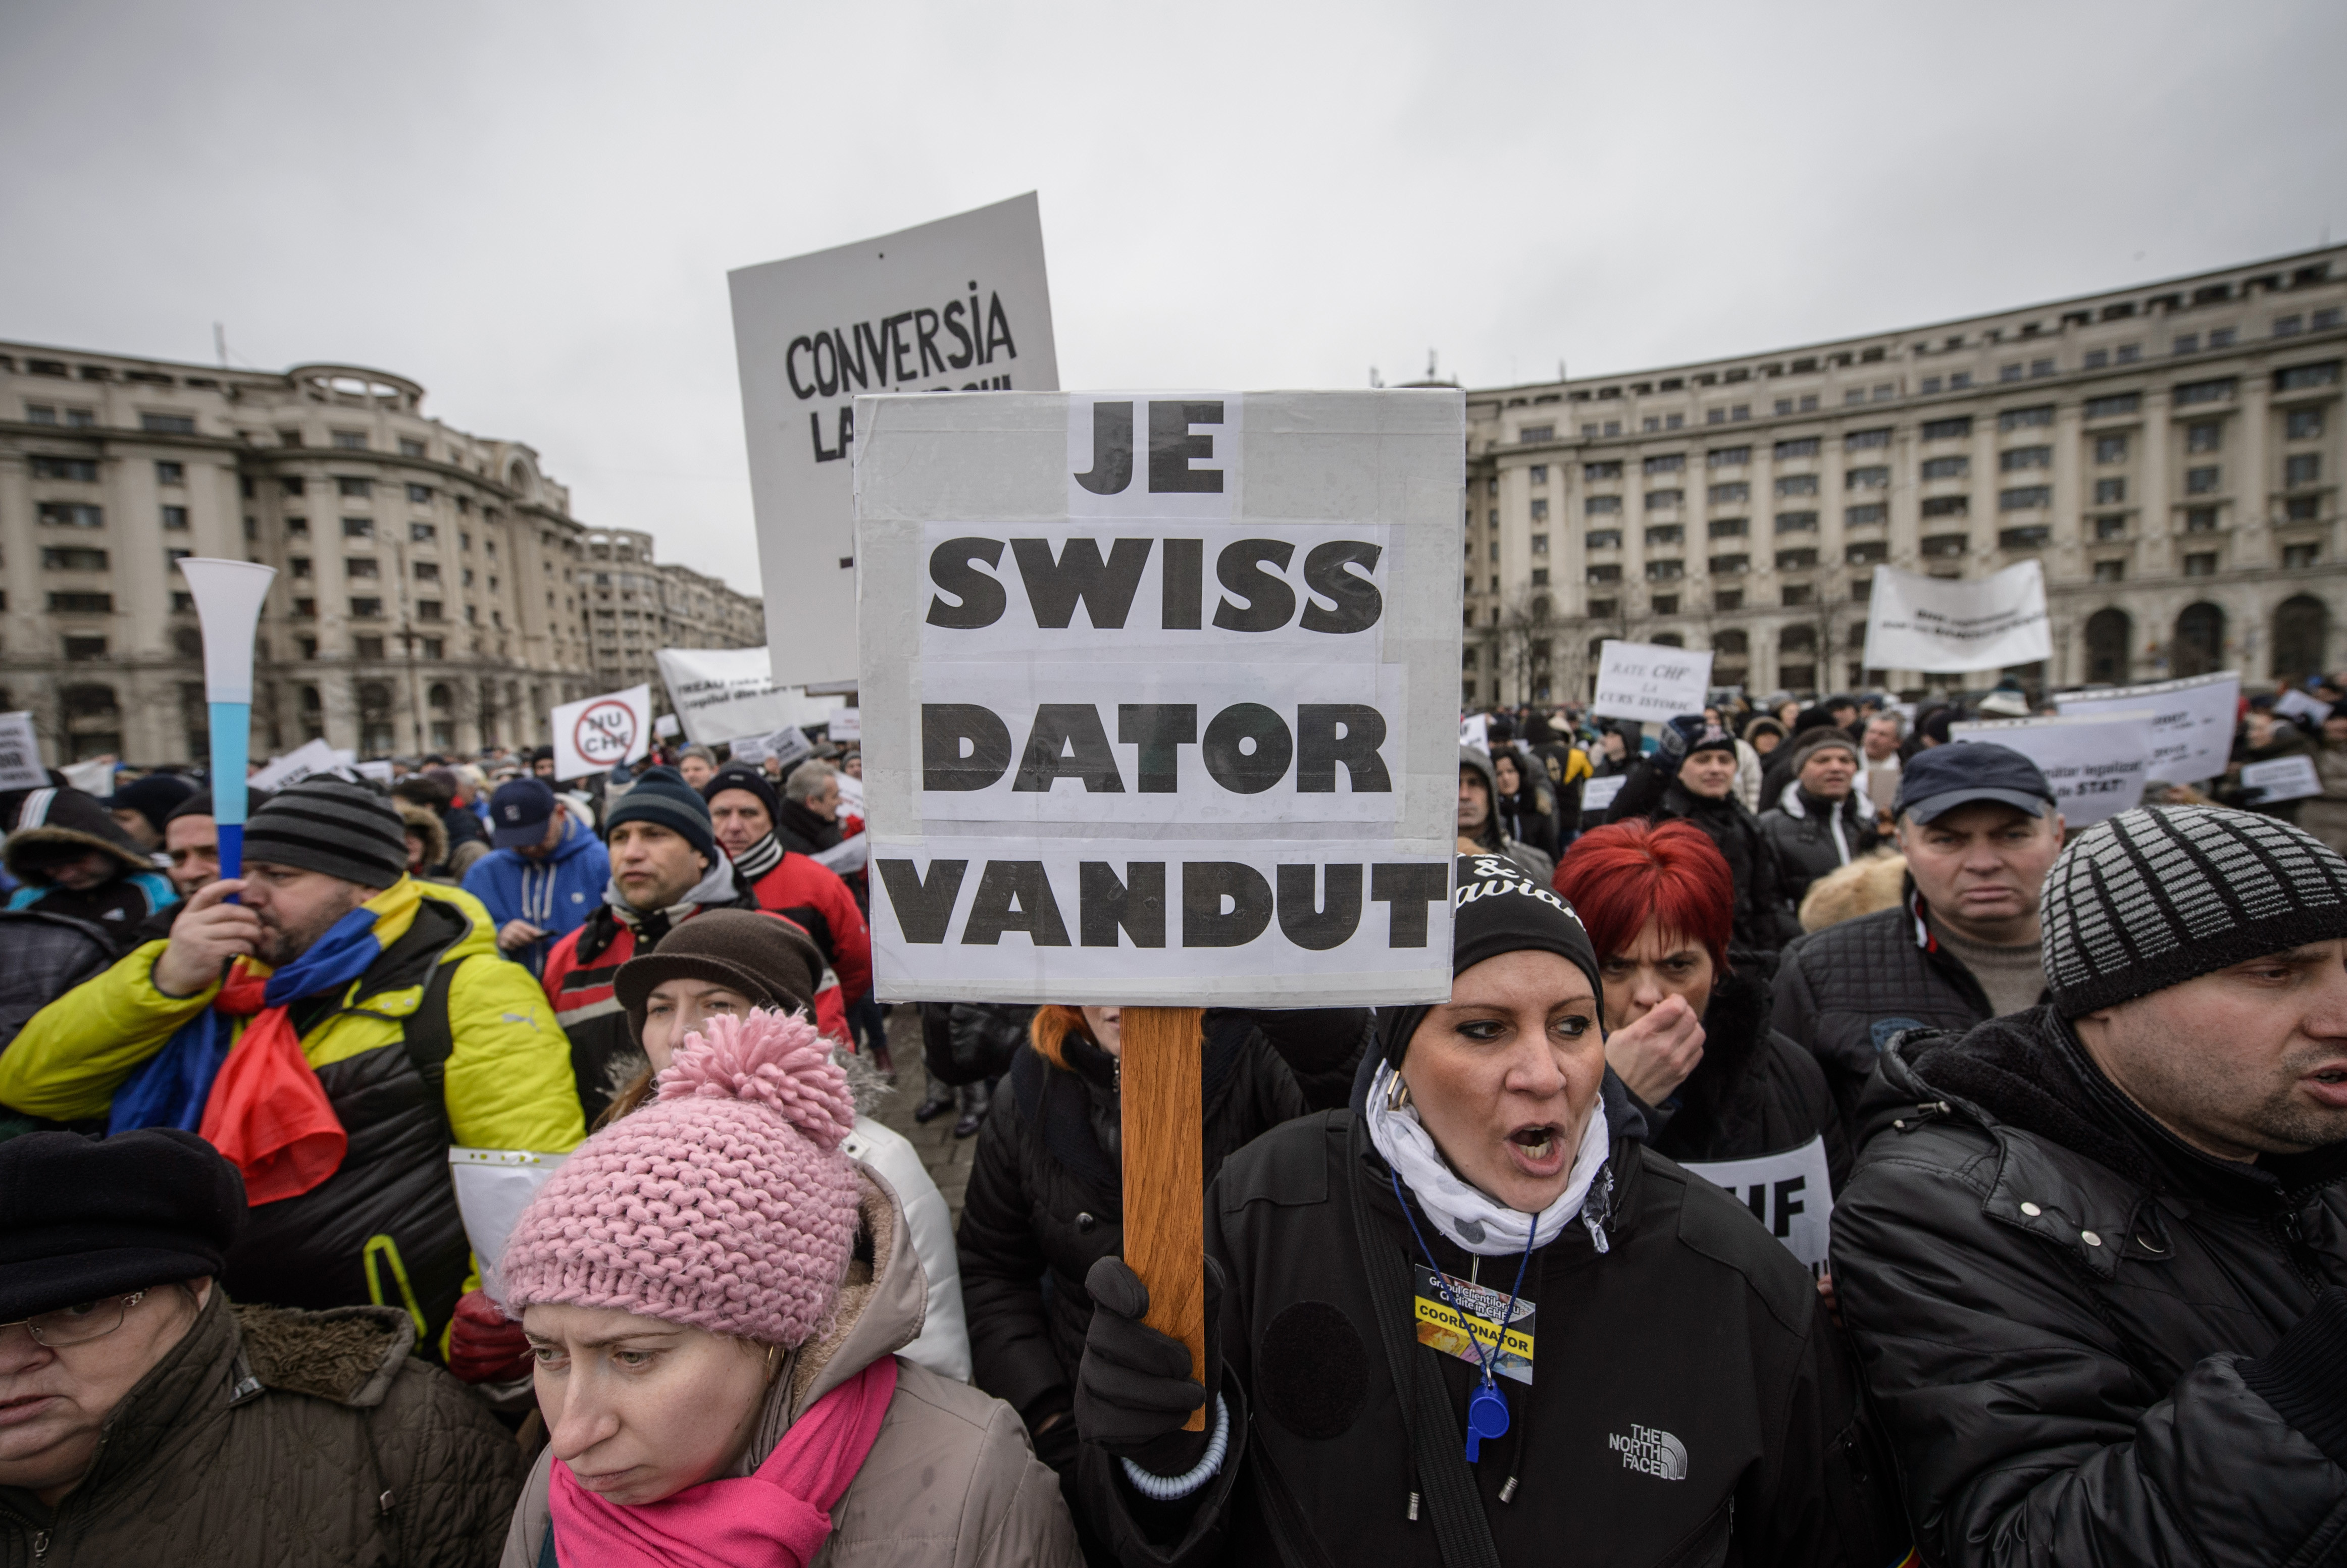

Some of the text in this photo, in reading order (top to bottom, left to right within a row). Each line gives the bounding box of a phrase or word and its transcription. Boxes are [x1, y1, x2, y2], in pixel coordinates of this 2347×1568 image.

[1073, 400, 1224, 495] JE
[926, 537, 1383, 634] SWISS
[1652, 664, 1690, 681] CHF
[588, 712, 622, 731] NU
[922, 703, 1392, 794] DATOR
[876, 859, 1448, 951] VANDUT
[1440, 1290, 1474, 1310] Crdite
[1486, 1306, 1508, 1321] CHF
[1507, 1303, 1519, 1315] u
[1609, 1433, 1661, 1461] NORTH
[1630, 1423, 1661, 1445] THE
[1623, 1452, 1661, 1476] FACE
